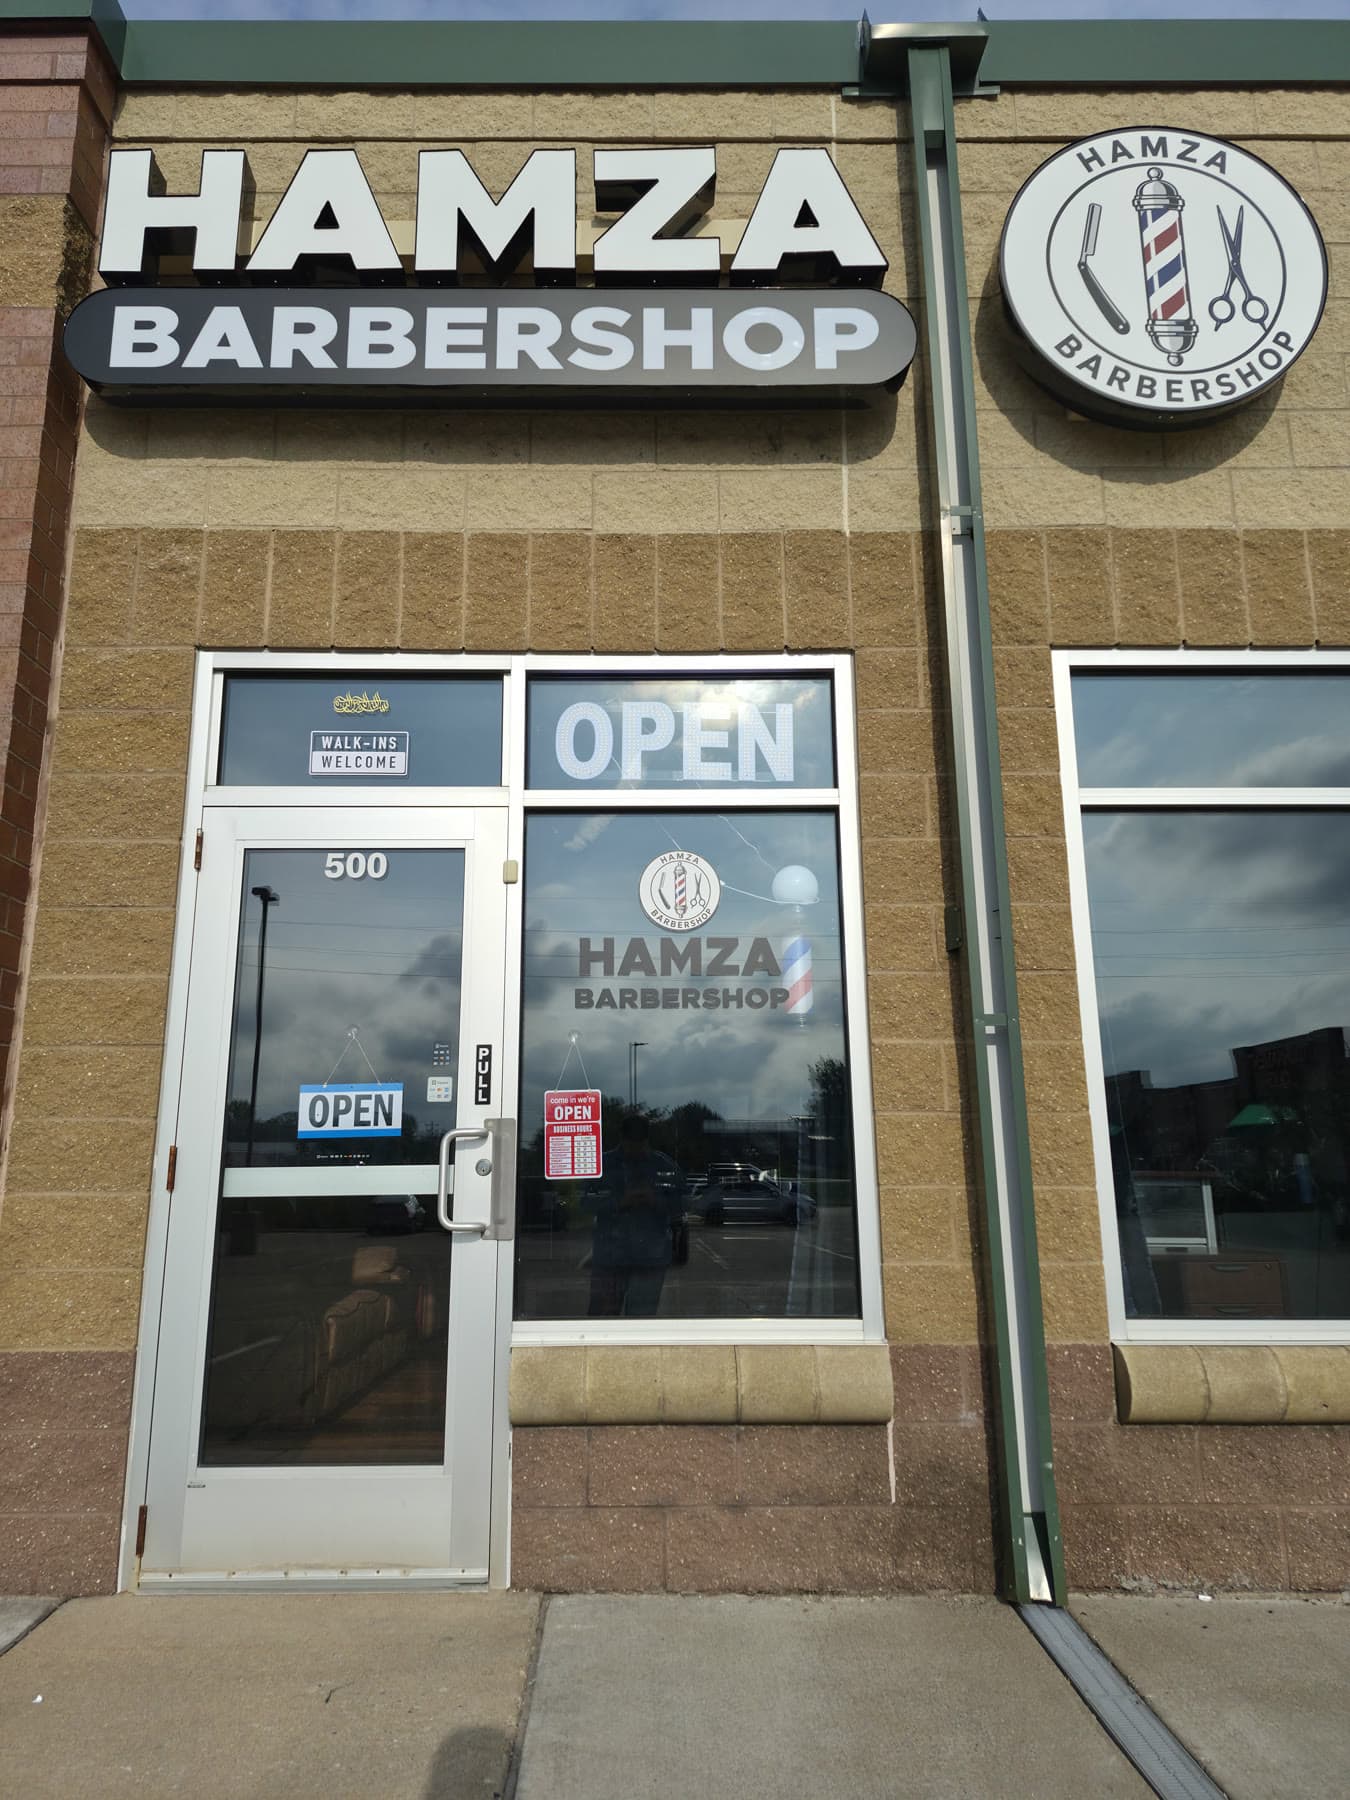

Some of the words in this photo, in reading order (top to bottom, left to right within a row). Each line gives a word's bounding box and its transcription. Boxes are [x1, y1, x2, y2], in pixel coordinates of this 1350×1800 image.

[1076, 135, 1228, 175] HAMZA
[98, 147, 889, 274] HAMZA
[109, 304, 880, 372] BARBERSHOP
[1054, 330, 1296, 403] BARBERSHOP
[321, 735, 397, 750] WALK-INS
[555, 701, 794, 781] OPEN
[321, 755, 396, 769] WELCOME
[324, 852, 388, 879] 500
[660, 852, 699, 865] HAMZA
[650, 908, 712, 929] BARBERSHOP
[578, 937, 782, 977] HAMZA
[573, 987, 790, 1010] BARBERSHOP
[478, 1047, 490, 1102] PULL
[308, 1093, 394, 1128] OPEN
[554, 1105, 592, 1121] OPEN
